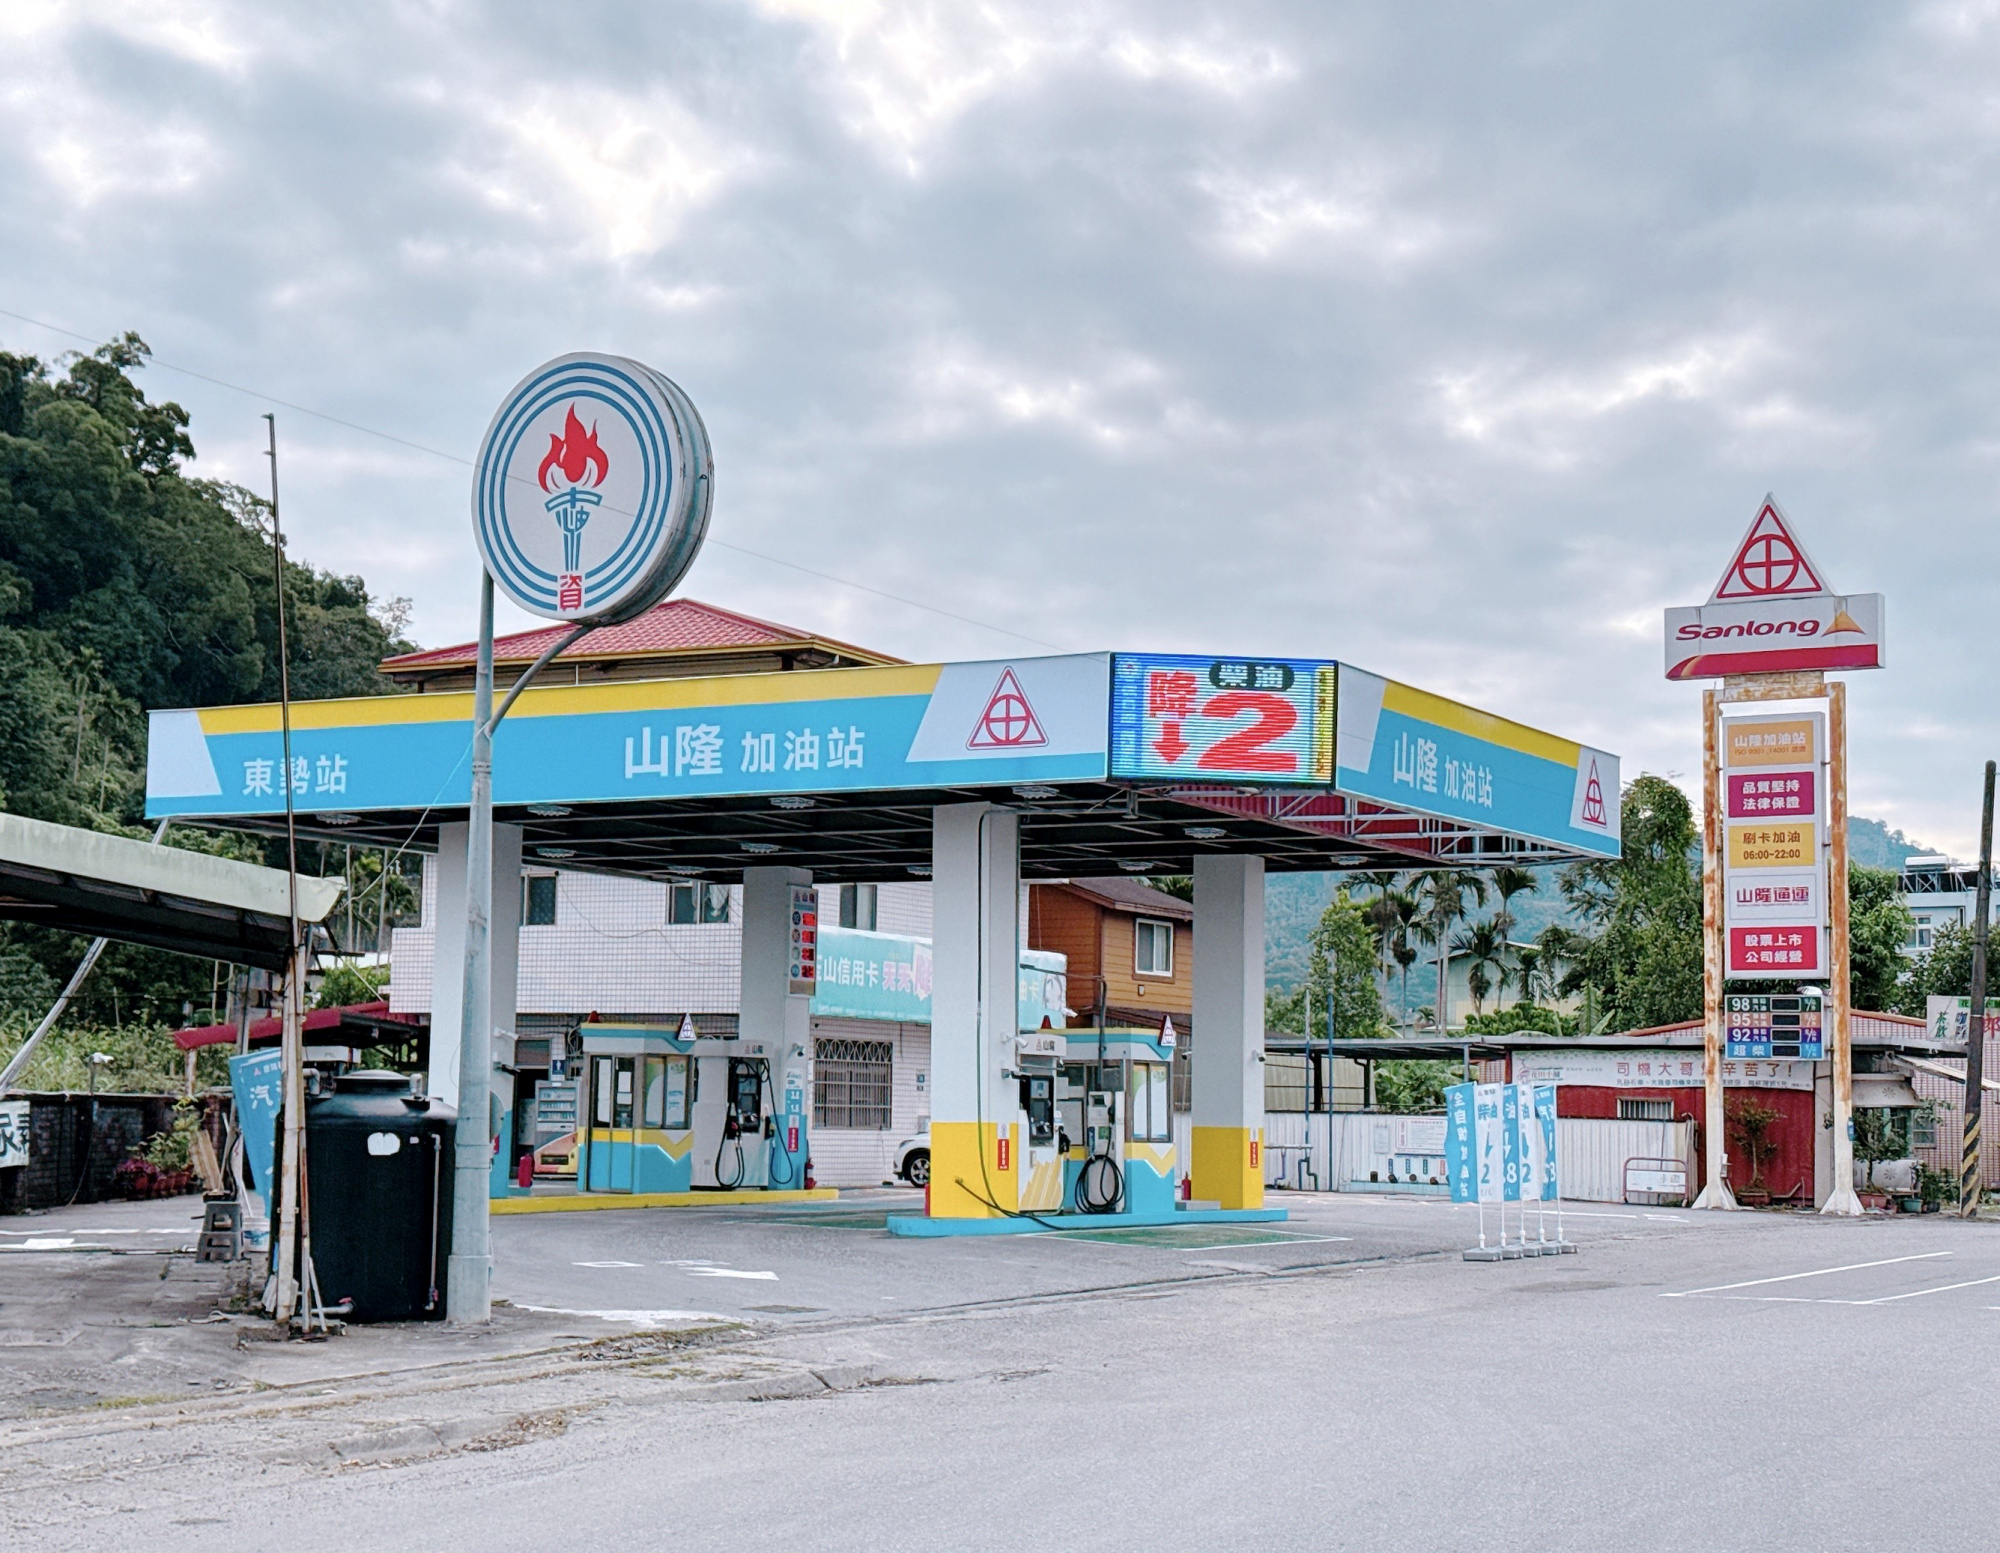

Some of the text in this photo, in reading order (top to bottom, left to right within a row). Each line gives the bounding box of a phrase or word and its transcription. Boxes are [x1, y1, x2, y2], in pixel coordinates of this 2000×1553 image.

[1675, 619, 1821, 641] Sanlong
[1196, 691, 1298, 772] 2
[1733, 731, 1807, 748] 山隆加油站
[623, 723, 867, 780] 山隆 加油站
[241, 753, 349, 797] 東勢站
[1392, 731, 1494, 810] 山隆 加油站
[1742, 779, 1801, 795] 品質堅持
[1742, 796, 1801, 811] 法律保證
[1742, 830, 1802, 845] 刷卡加油
[1742, 848, 1802, 861] 06:00~22:00
[1736, 886, 1810, 903] 山隆通運
[1744, 933, 1803, 947] 股票上市
[1744, 950, 1803, 964] 公司經營
[1731, 997, 1751, 1012] 98
[1731, 1013, 1752, 1027] 95
[1731, 1028, 1752, 1042] 92
[1616, 1061, 1792, 1078] 司機大哥辛苦了!
